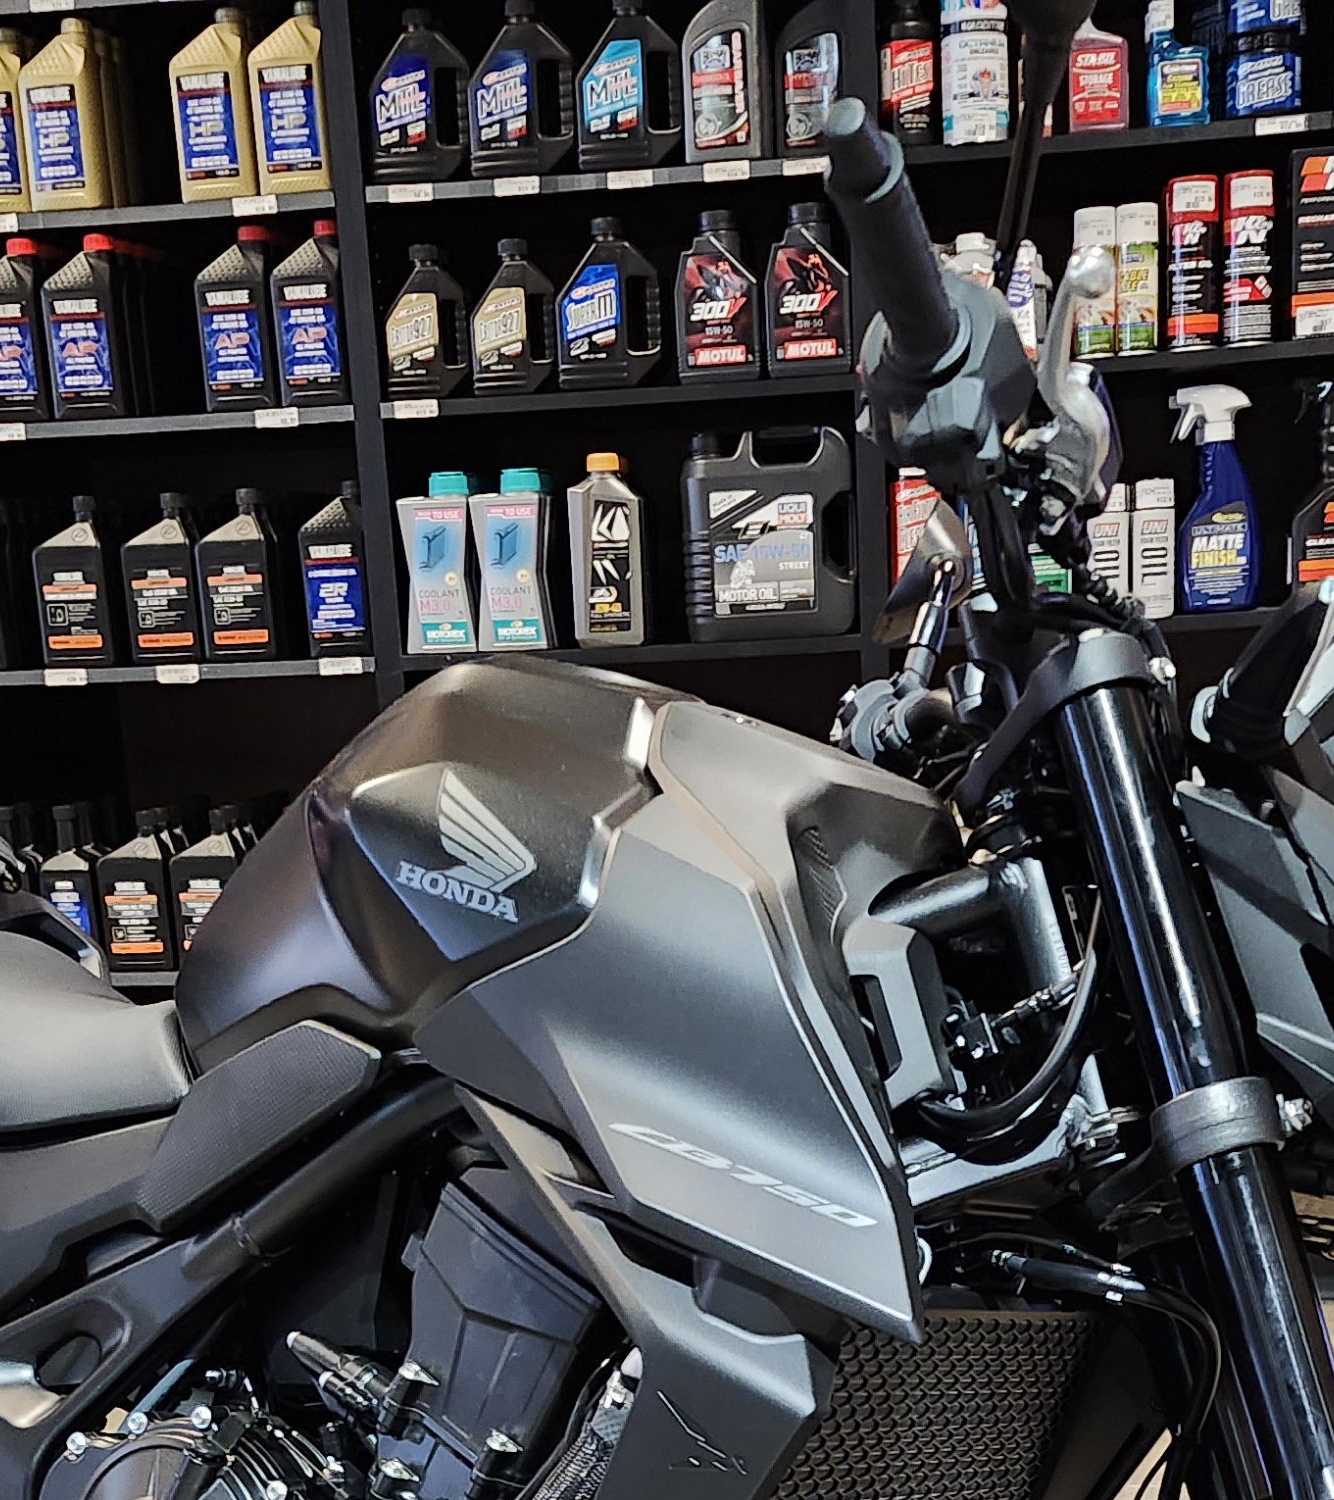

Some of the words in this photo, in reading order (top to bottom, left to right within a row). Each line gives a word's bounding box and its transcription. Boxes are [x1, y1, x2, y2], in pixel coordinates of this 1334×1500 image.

[690, 297, 747, 321] 300V
[779, 290, 838, 314] 300V
[214, 332, 250, 350] AP
[291, 326, 327, 345] AP
[697, 348, 745, 364] MOTUL
[786, 341, 835, 357] MOTUL
[444, 511, 460, 519] USE
[516, 508, 533, 516] USE
[1093, 522, 1120, 538] UNI
[1142, 519, 1168, 535] UNI
[1192, 533, 1244, 551] MATTE
[714, 544, 749, 563] SAE
[1191, 550, 1236, 568] FINISH
[779, 561, 809, 570] STREET
[419, 589, 459, 598] COOLANT
[490, 586, 532, 596] COOLANT
[719, 589, 758, 602] MOTOR
[759, 588, 778, 600] OIL
[396, 859, 520, 925] HONDA
[608, 1121, 879, 1229] CB750
